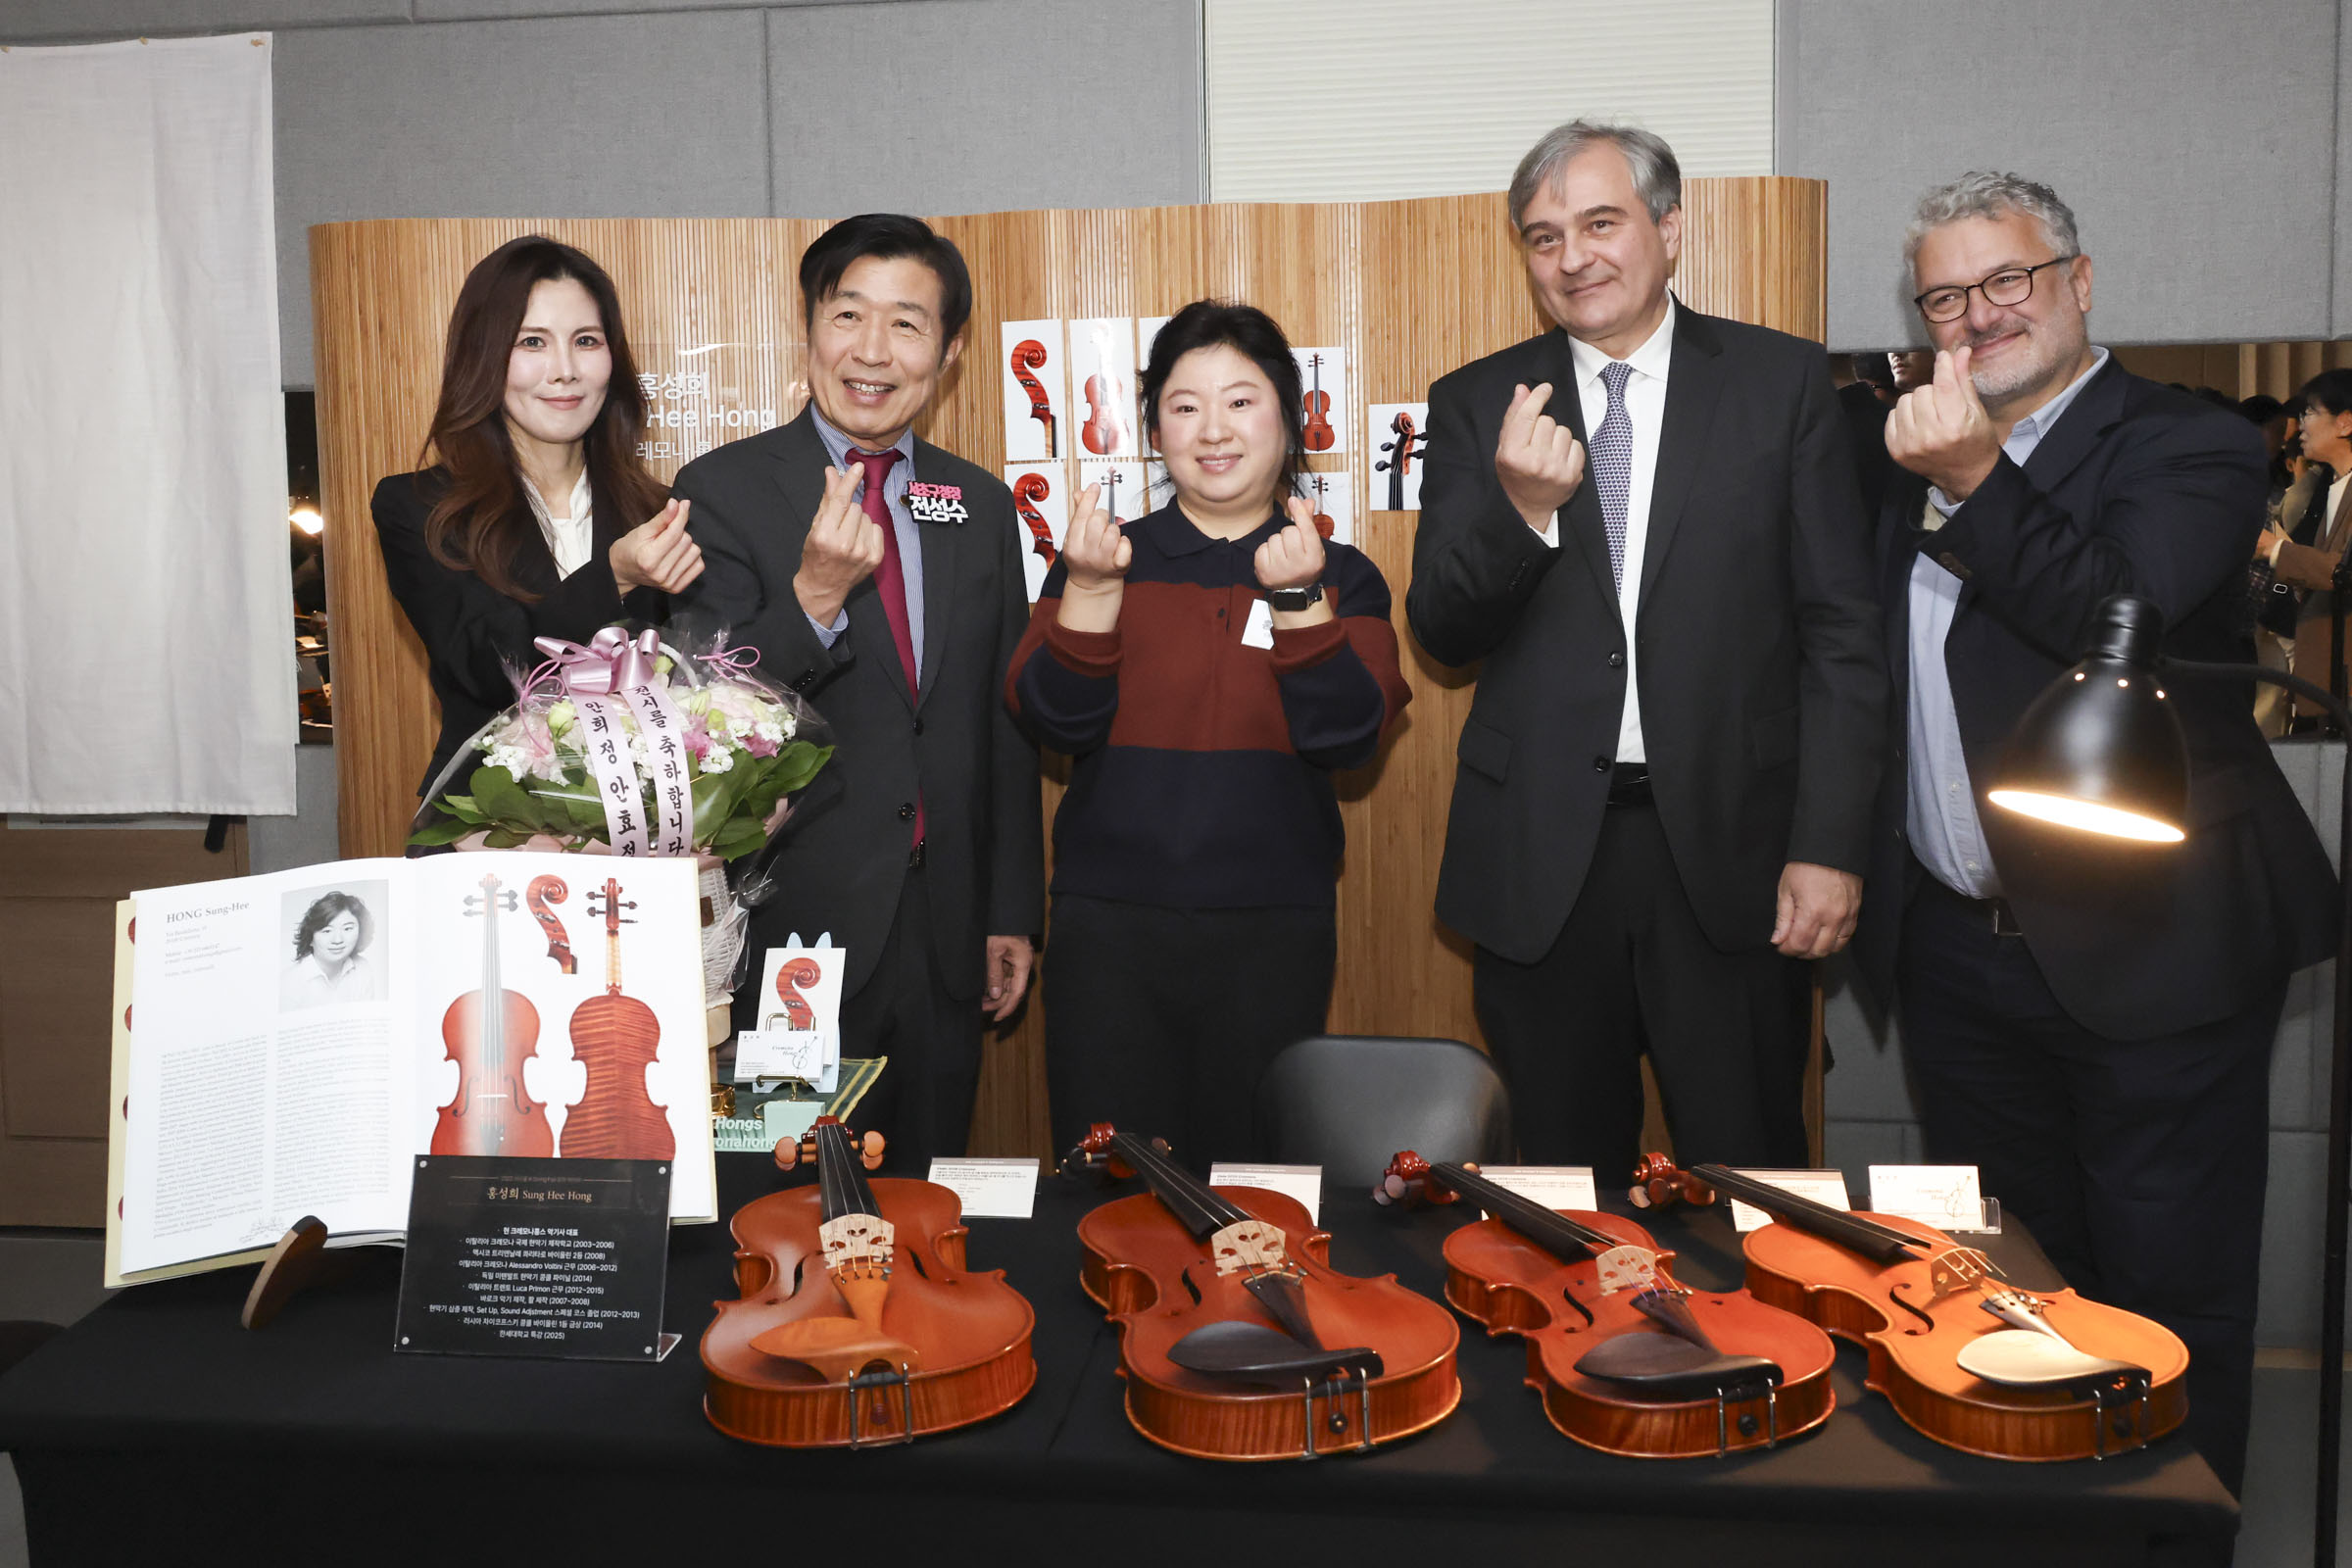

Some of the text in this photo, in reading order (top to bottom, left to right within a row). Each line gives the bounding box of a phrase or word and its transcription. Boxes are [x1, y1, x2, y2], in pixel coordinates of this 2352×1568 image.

[636, 371, 710, 400] 홍성희
[646, 403, 777, 433] Hee Hong
[908, 481, 962, 501] 서초구청장
[908, 495, 969, 524] 전성수
[584, 701, 618, 765] 안희정
[634, 685, 685, 858] 전시를 축하합니다
[166, 901, 251, 924] HONG Sung-Hee
[714, 1115, 763, 1132] Hongs
[713, 1134, 778, 1150] onahong
[487, 1186, 592, 1203] 홍성희 Sung Hee Hong
[465, 1237, 490, 1246] 이탈리아
[490, 1238, 514, 1247] 크레모나
[515, 1238, 528, 1247] 국제
[458, 1259, 483, 1268] 이탈리아
[483, 1260, 508, 1269] 크레모나
[508, 1261, 543, 1270] Alessandro
[564, 1262, 576, 1271] 근무
[481, 1271, 494, 1281] 독일
[572, 1274, 593, 1284] (2014)
[467, 1283, 493, 1292] 이탈리아
[528, 1285, 551, 1294] Primon
[564, 1286, 605, 1295] (2012~2015)
[549, 1298, 590, 1306] (2007~2008)
[476, 1305, 487, 1314] Set
[500, 1307, 520, 1316] Sound
[600, 1310, 640, 1319] (2012~2013)
[582, 1321, 604, 1331] (2014)
[544, 1331, 565, 1341] (2025)
